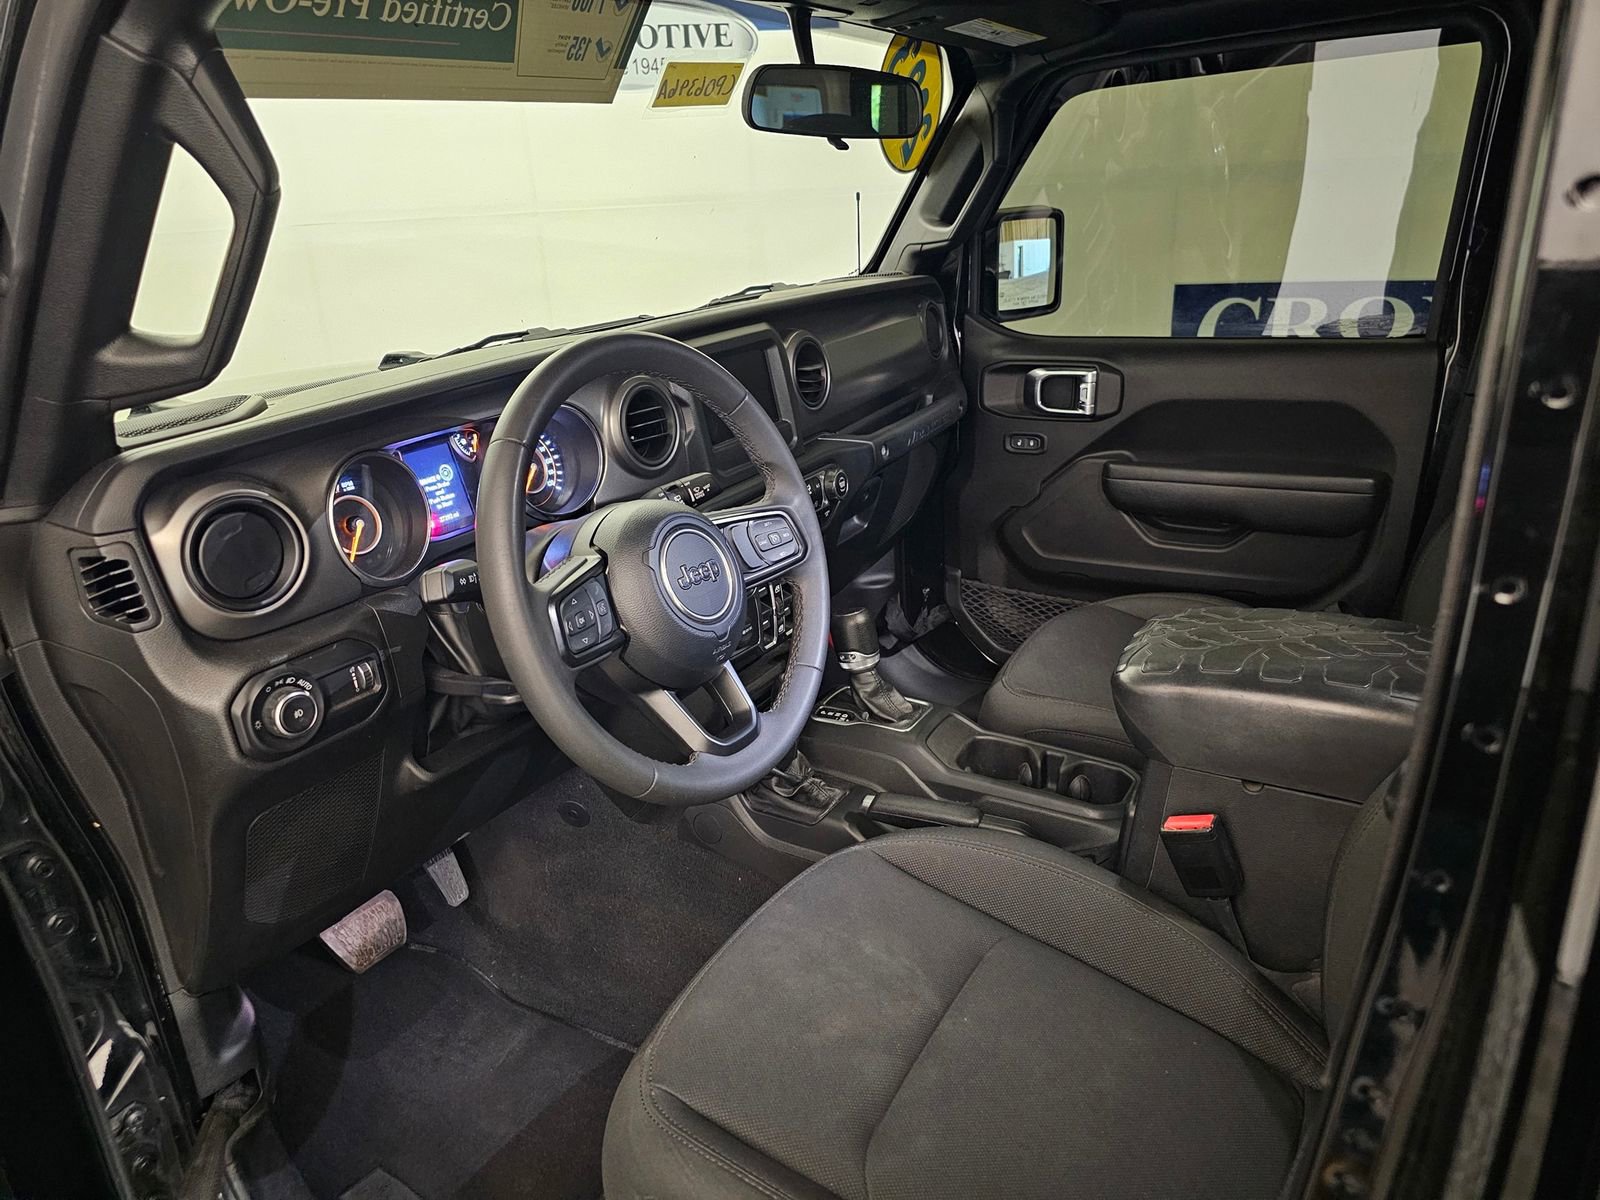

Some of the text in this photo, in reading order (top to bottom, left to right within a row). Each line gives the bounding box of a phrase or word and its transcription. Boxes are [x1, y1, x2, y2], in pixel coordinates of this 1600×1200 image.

[1197, 295, 1434, 338] CRO
[677, 558, 721, 590] Jeep
[297, 678, 313, 691] AUTO
